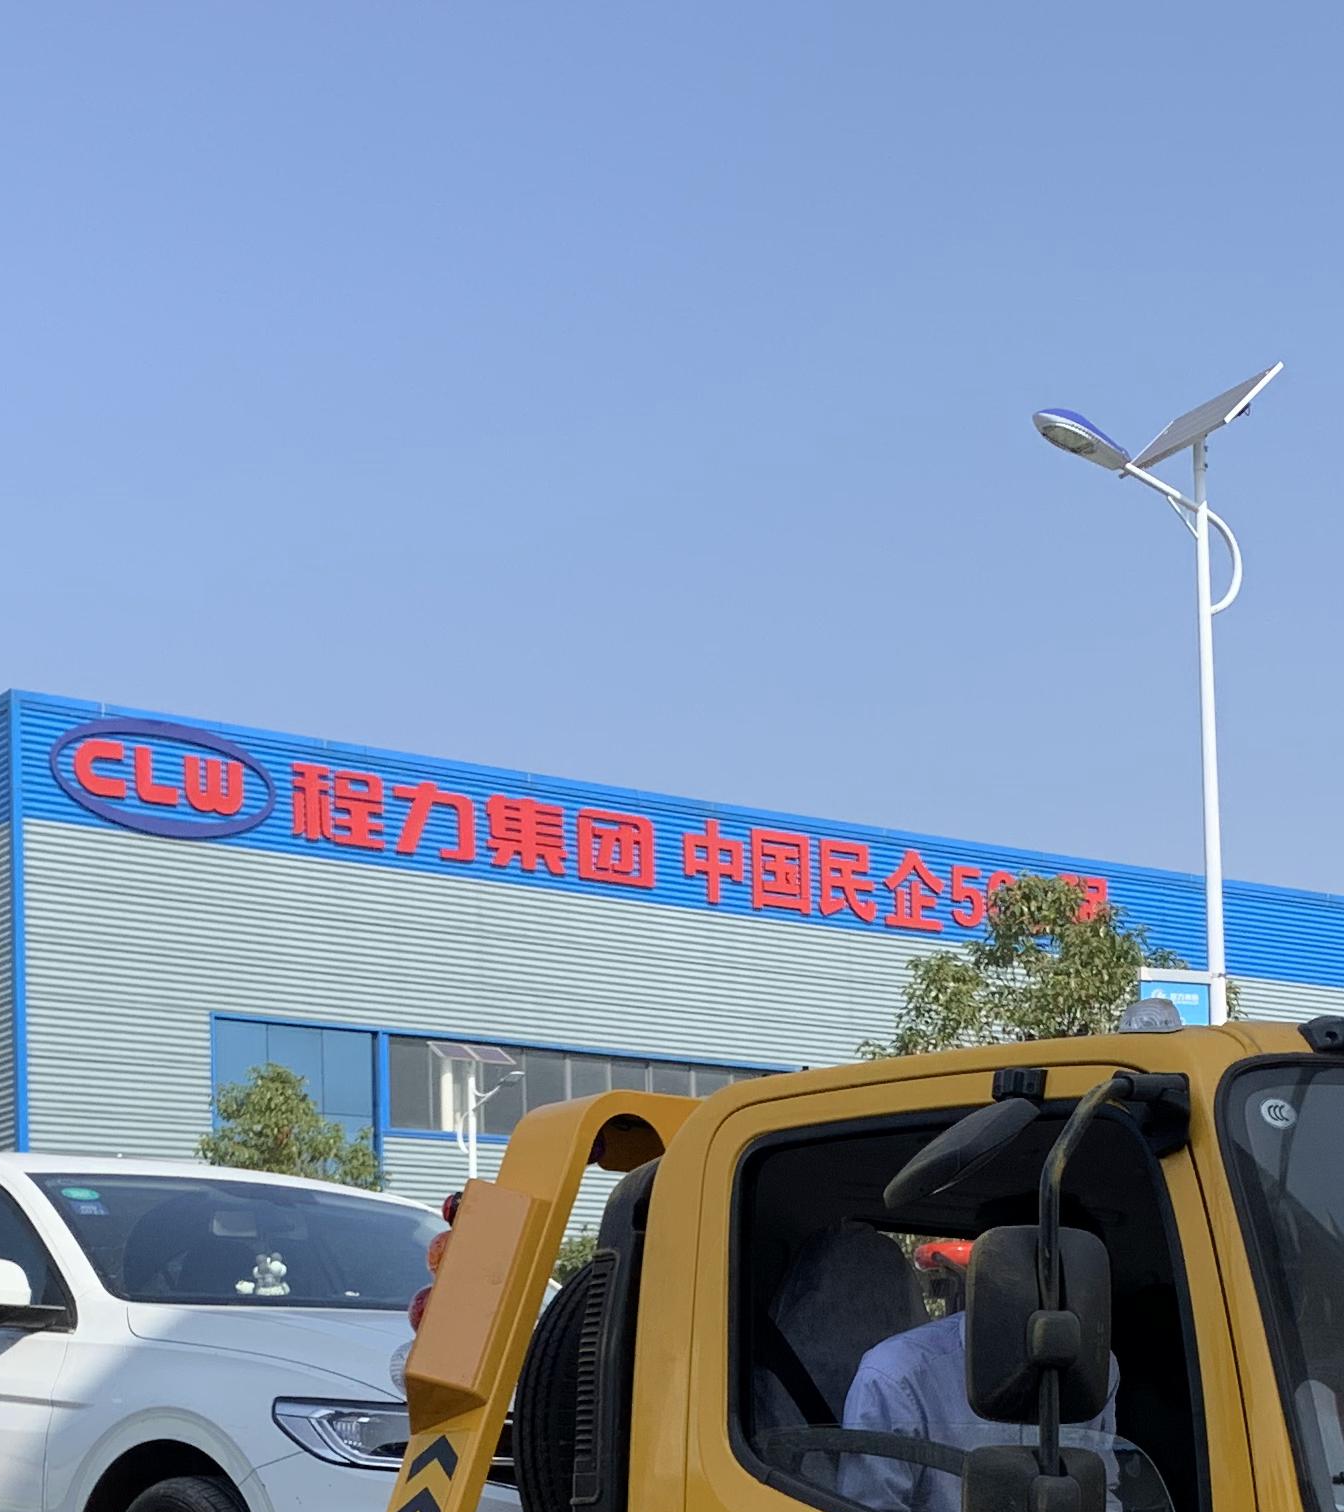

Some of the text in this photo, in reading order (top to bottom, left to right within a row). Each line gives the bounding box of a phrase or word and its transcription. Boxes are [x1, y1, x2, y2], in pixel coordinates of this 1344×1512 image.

[73, 739, 1109, 932] CLW 程力集团 中国民企5
